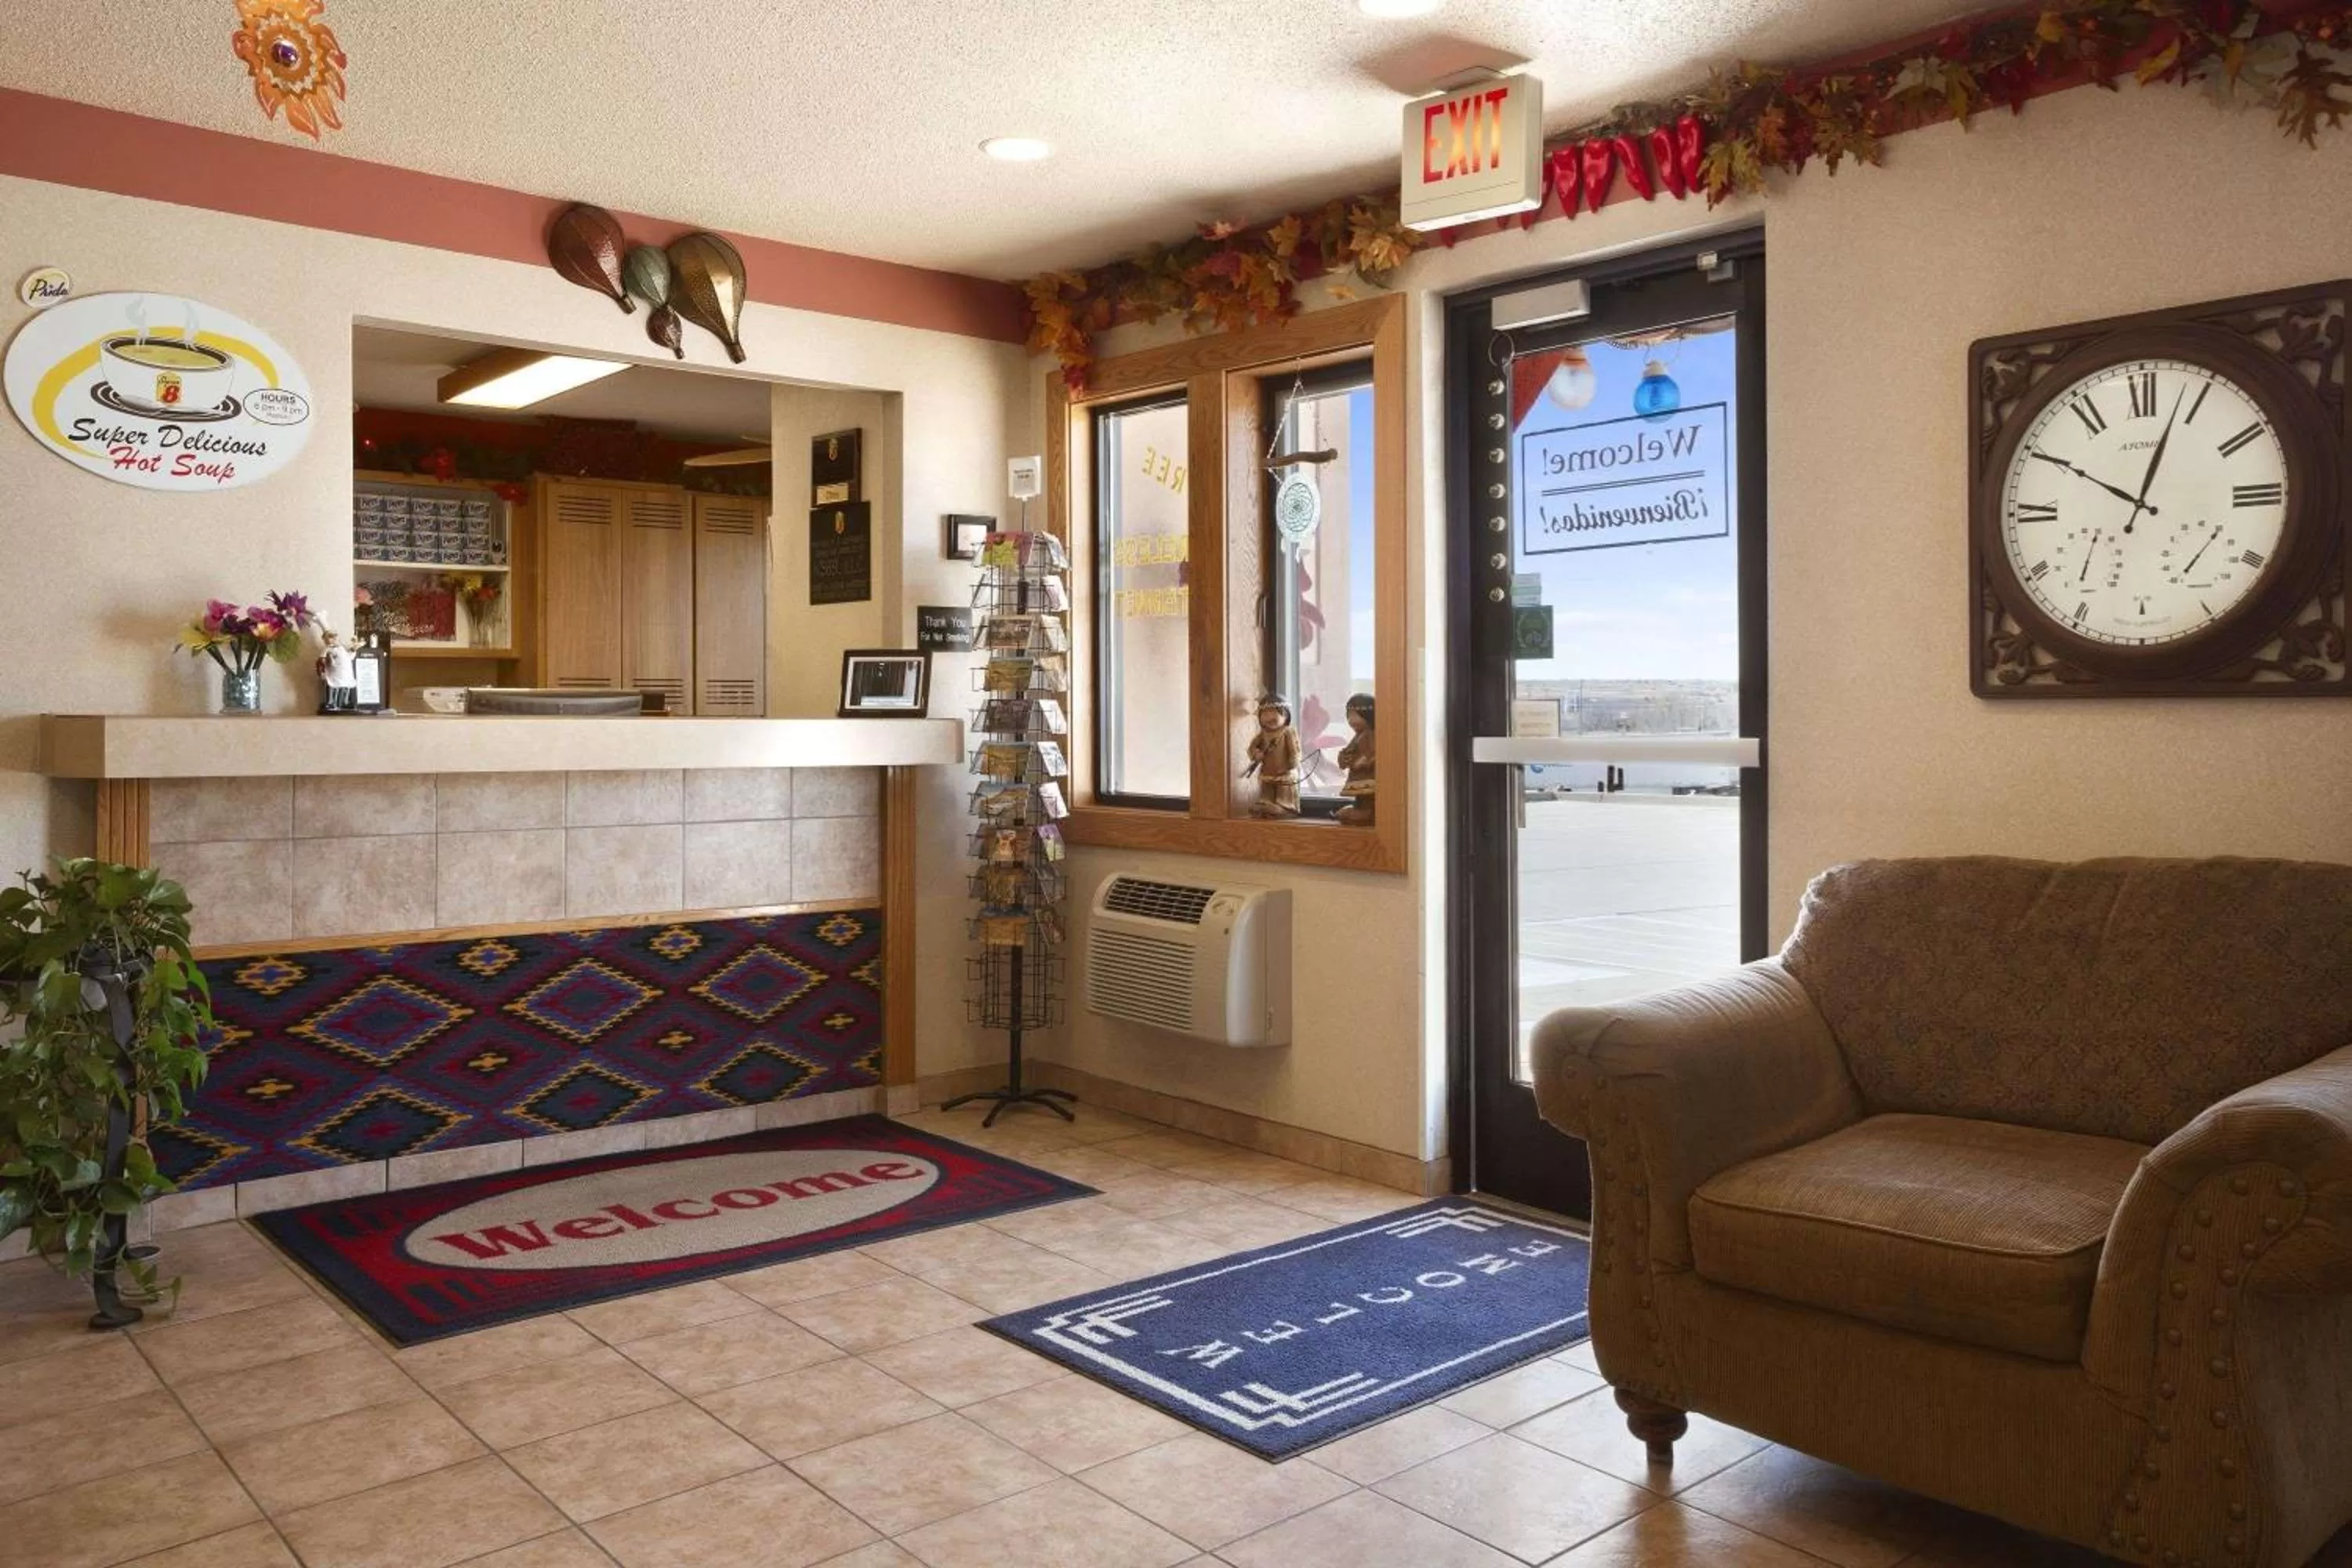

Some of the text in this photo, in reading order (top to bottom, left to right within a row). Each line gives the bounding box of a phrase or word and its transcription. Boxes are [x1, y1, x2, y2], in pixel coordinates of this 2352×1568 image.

[1424, 88, 1508, 184] EXIT
[29, 278, 69, 300] Pride
[162, 385, 180, 403] 8
[261, 393, 296, 404] HOURS
[68, 418, 267, 456] Super Delicious
[110, 446, 236, 483] Hot Soup
[924, 615, 967, 628] Thank You
[433, 1156, 925, 1260] Welcome
[1157, 1240, 1562, 1369] WELCOME
